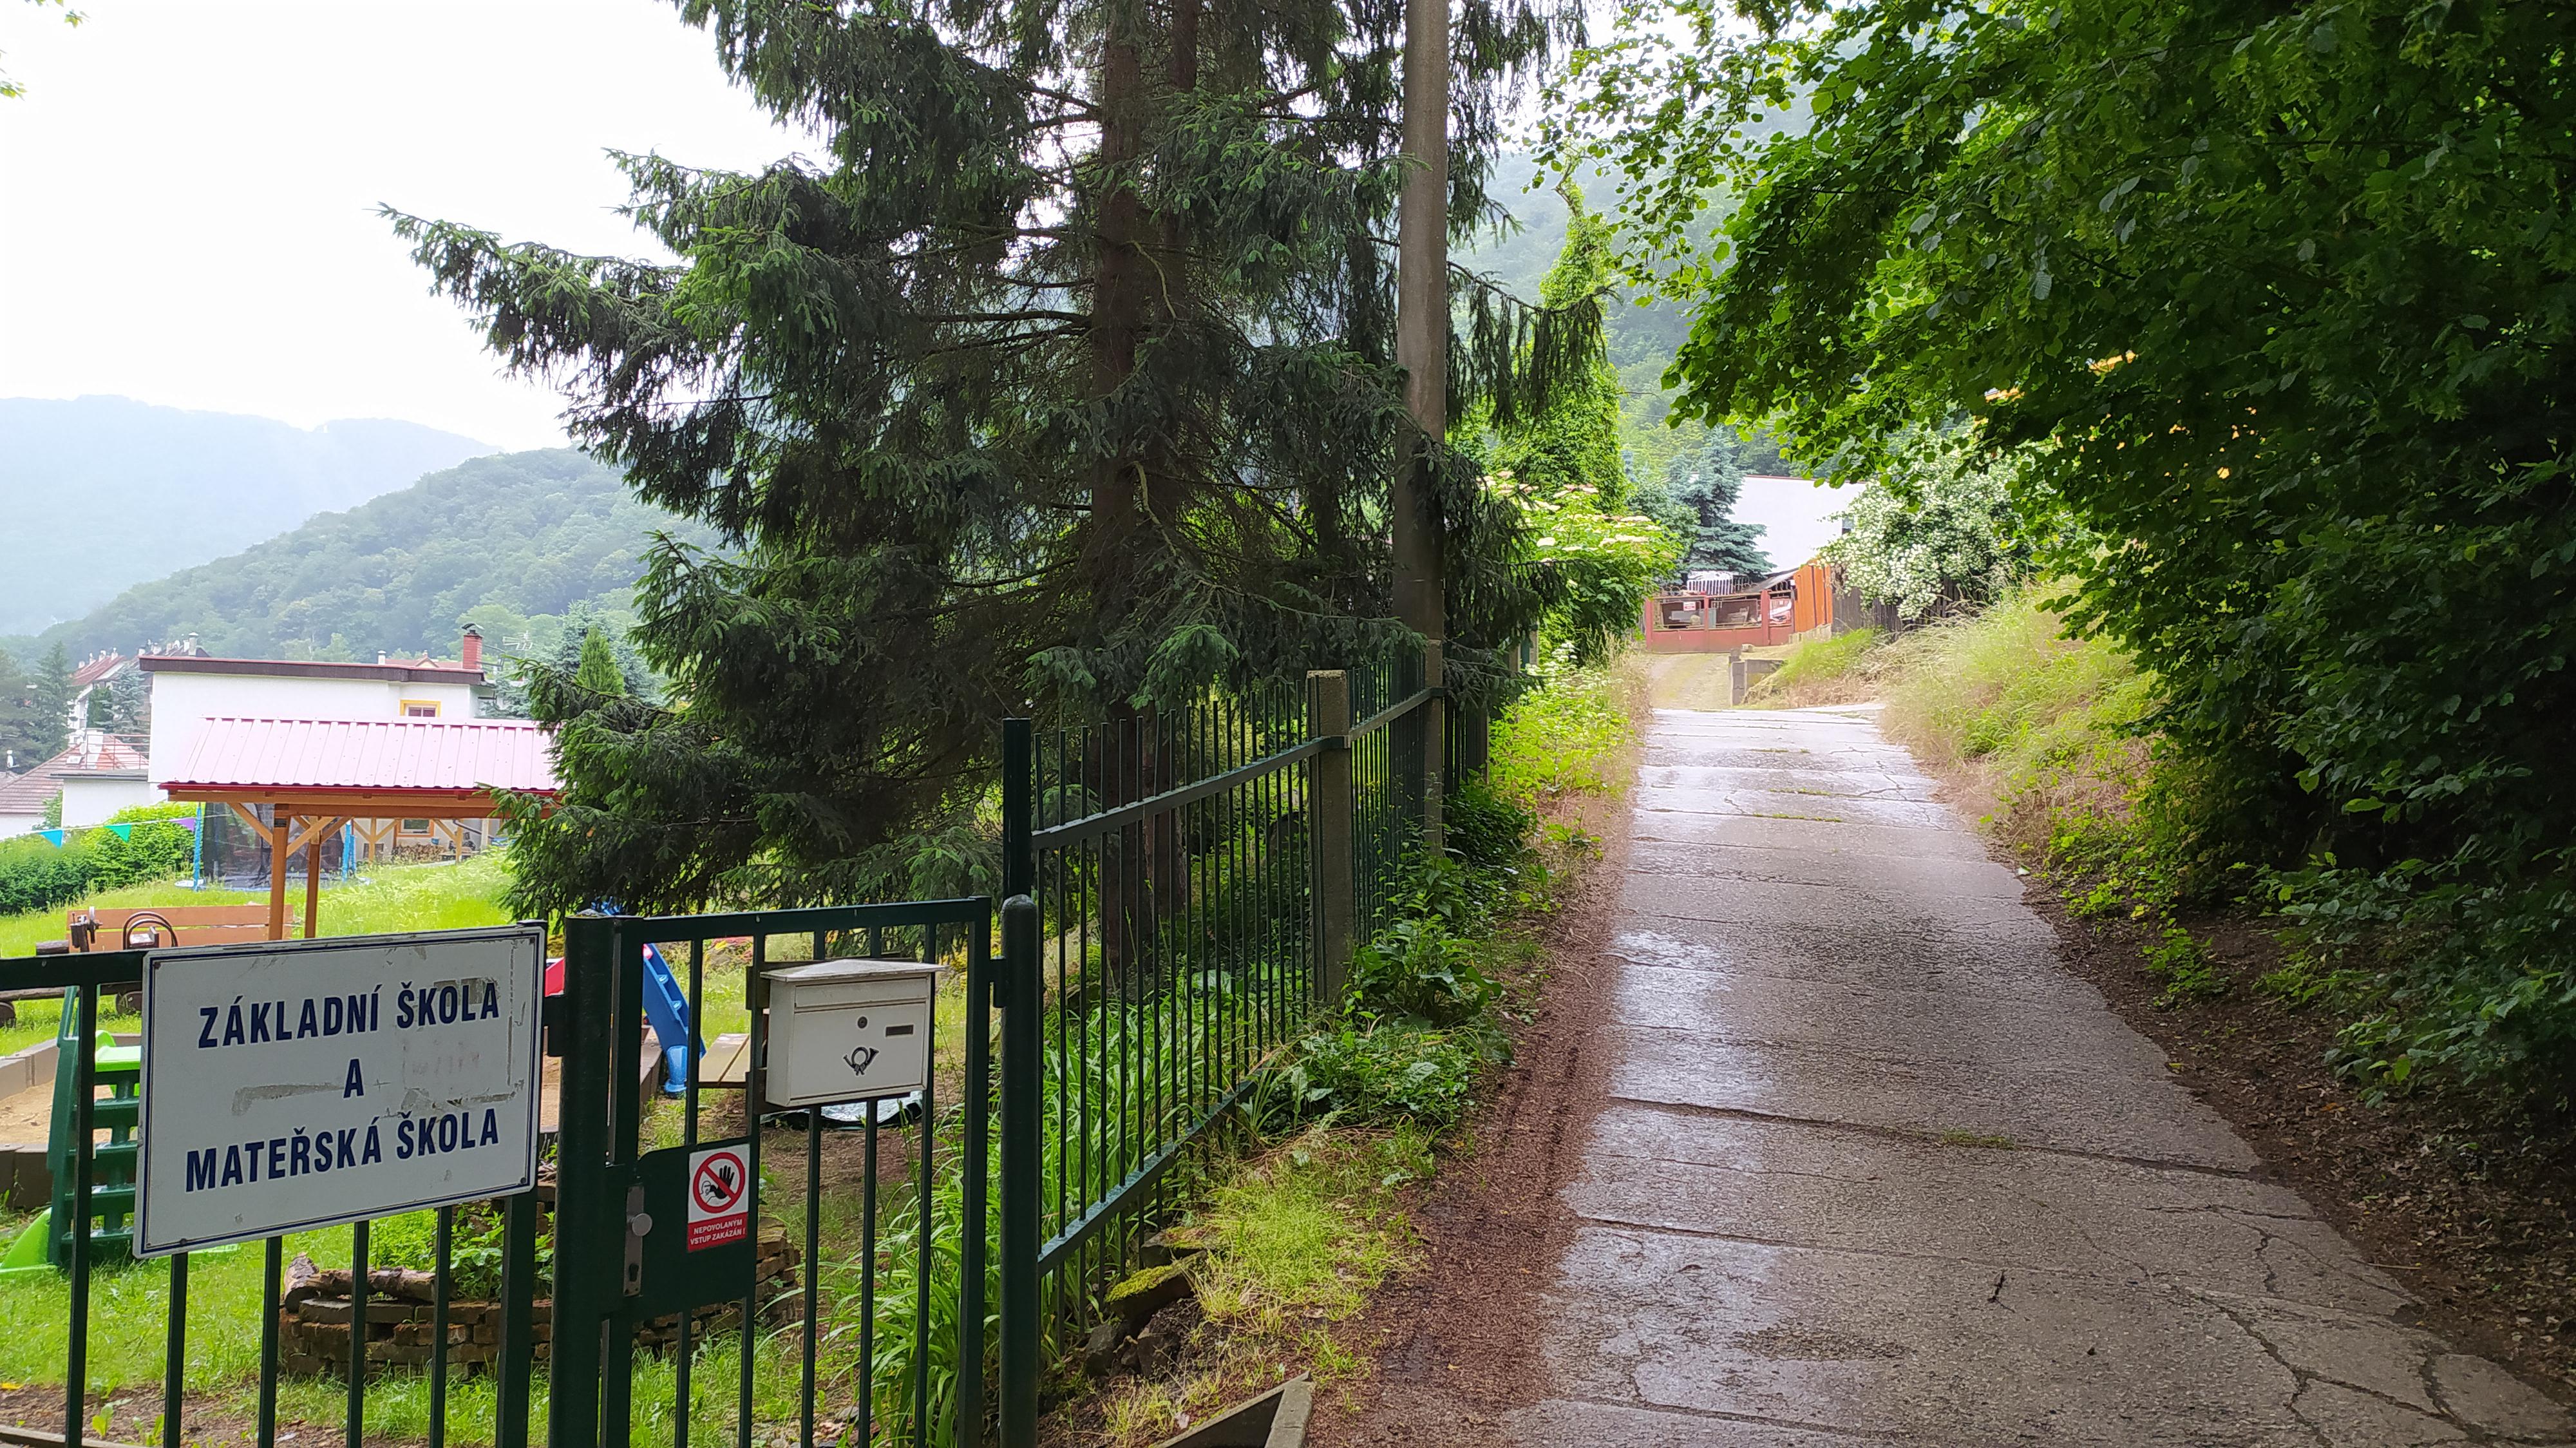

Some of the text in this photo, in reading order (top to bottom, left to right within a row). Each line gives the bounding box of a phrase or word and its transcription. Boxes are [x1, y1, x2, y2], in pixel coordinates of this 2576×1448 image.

[198, 981, 499, 1049] ZÁKLADNÍ ŠKOLA
[343, 1058, 365, 1098] A
[185, 1108, 498, 1192] MATEŘSKÁ ŠKOLA
[690, 1234, 712, 1245] VSTUP
[712, 1228, 742, 1241] ZAKÁZÁN
[694, 1218, 743, 1235] NEPOVOLANÝM
